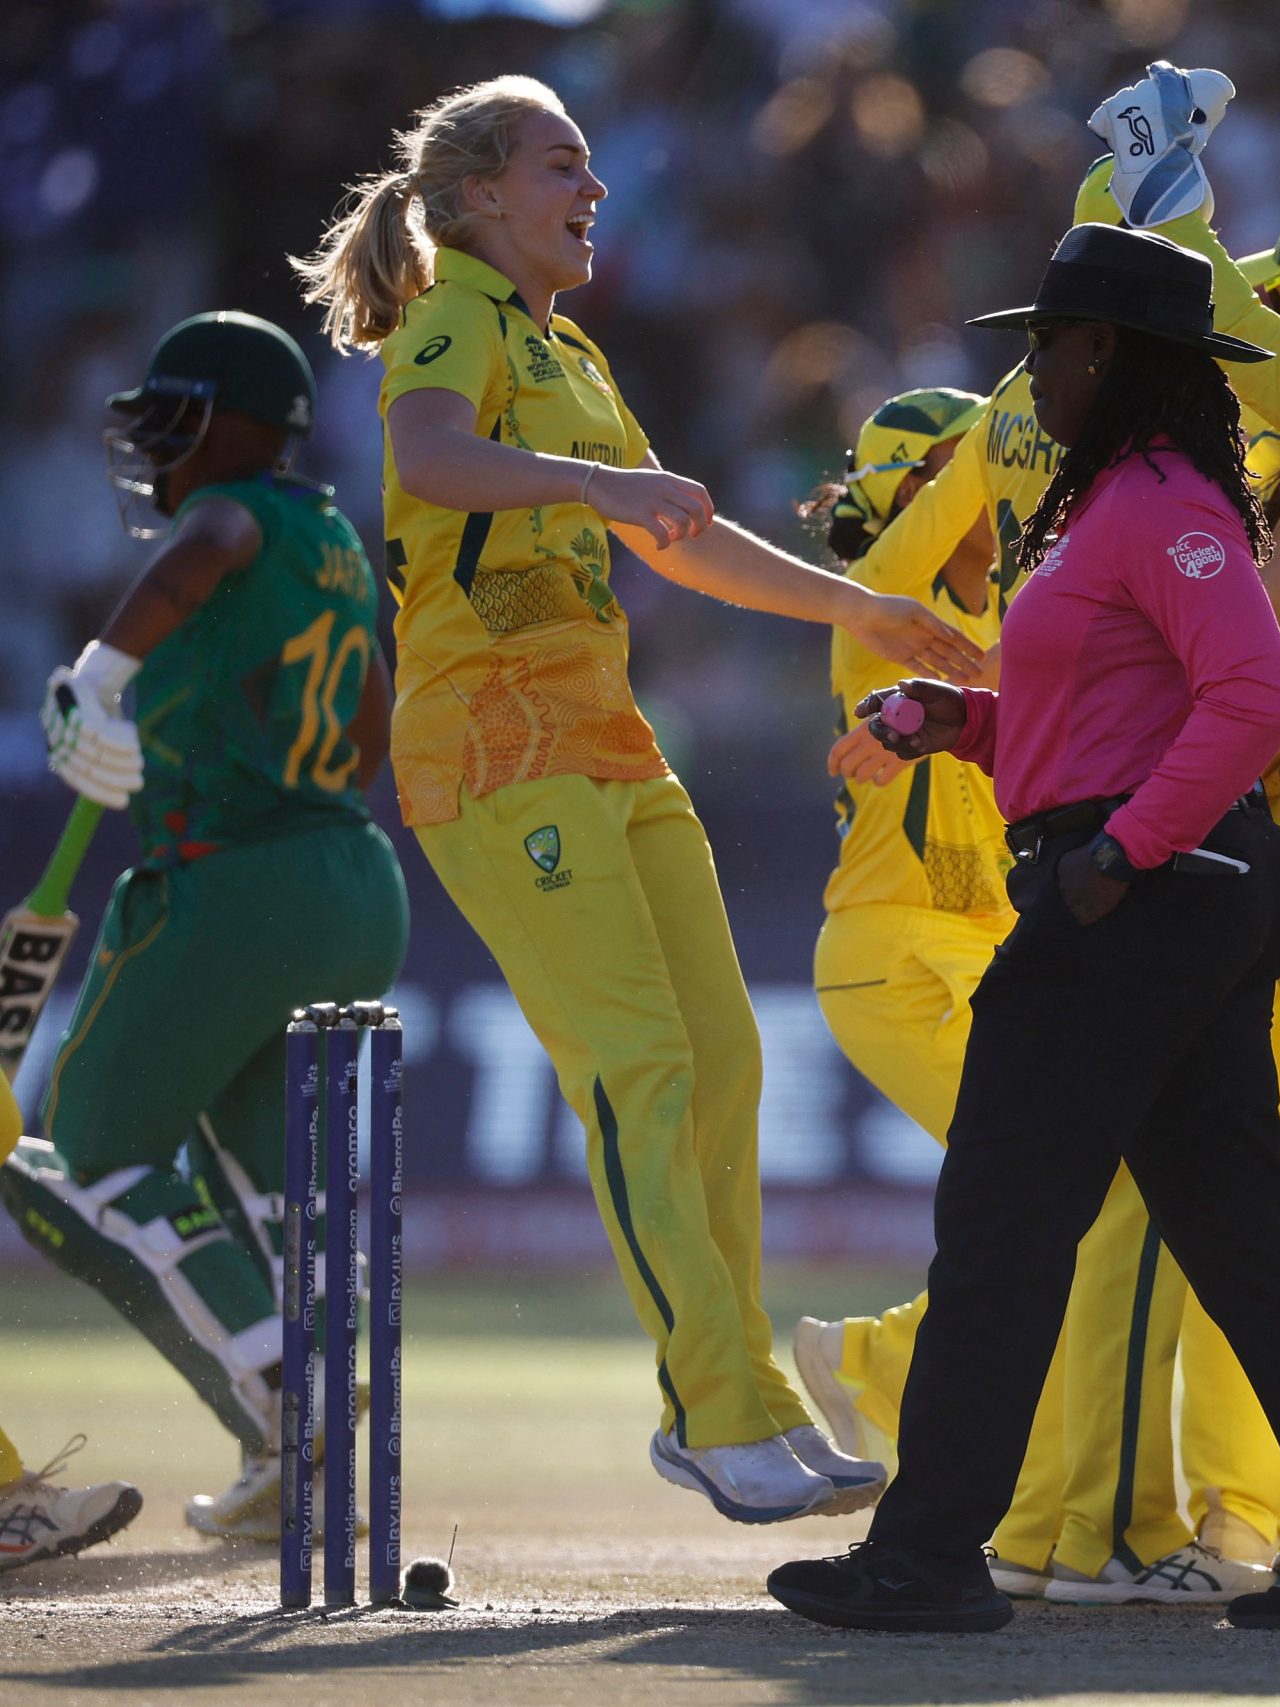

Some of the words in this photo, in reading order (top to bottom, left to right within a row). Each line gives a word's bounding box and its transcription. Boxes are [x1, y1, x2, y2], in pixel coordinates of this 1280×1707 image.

[1178, 544, 1217, 563] Cricket
[1185, 560, 1202, 579] 4
[1194, 550, 1222, 569] good
[281, 608, 369, 794] 10
[535, 868, 573, 889] CRICKET
[308, 1109, 318, 1198] BharatPe
[348, 1105, 358, 1193] aramco
[392, 1105, 403, 1193] BharatPe
[346, 1208, 357, 1329] Booking.com
[391, 1234, 402, 1301] BYJU'S
[304, 1351, 315, 1439] BharatPe
[347, 1344, 357, 1431] aramco
[390, 1345, 402, 1434] BharatPe
[303, 1480, 313, 1546] BYJU'S
[344, 1448, 356, 1569] Booking.com
[389, 1474, 401, 1541] BYJU'S
